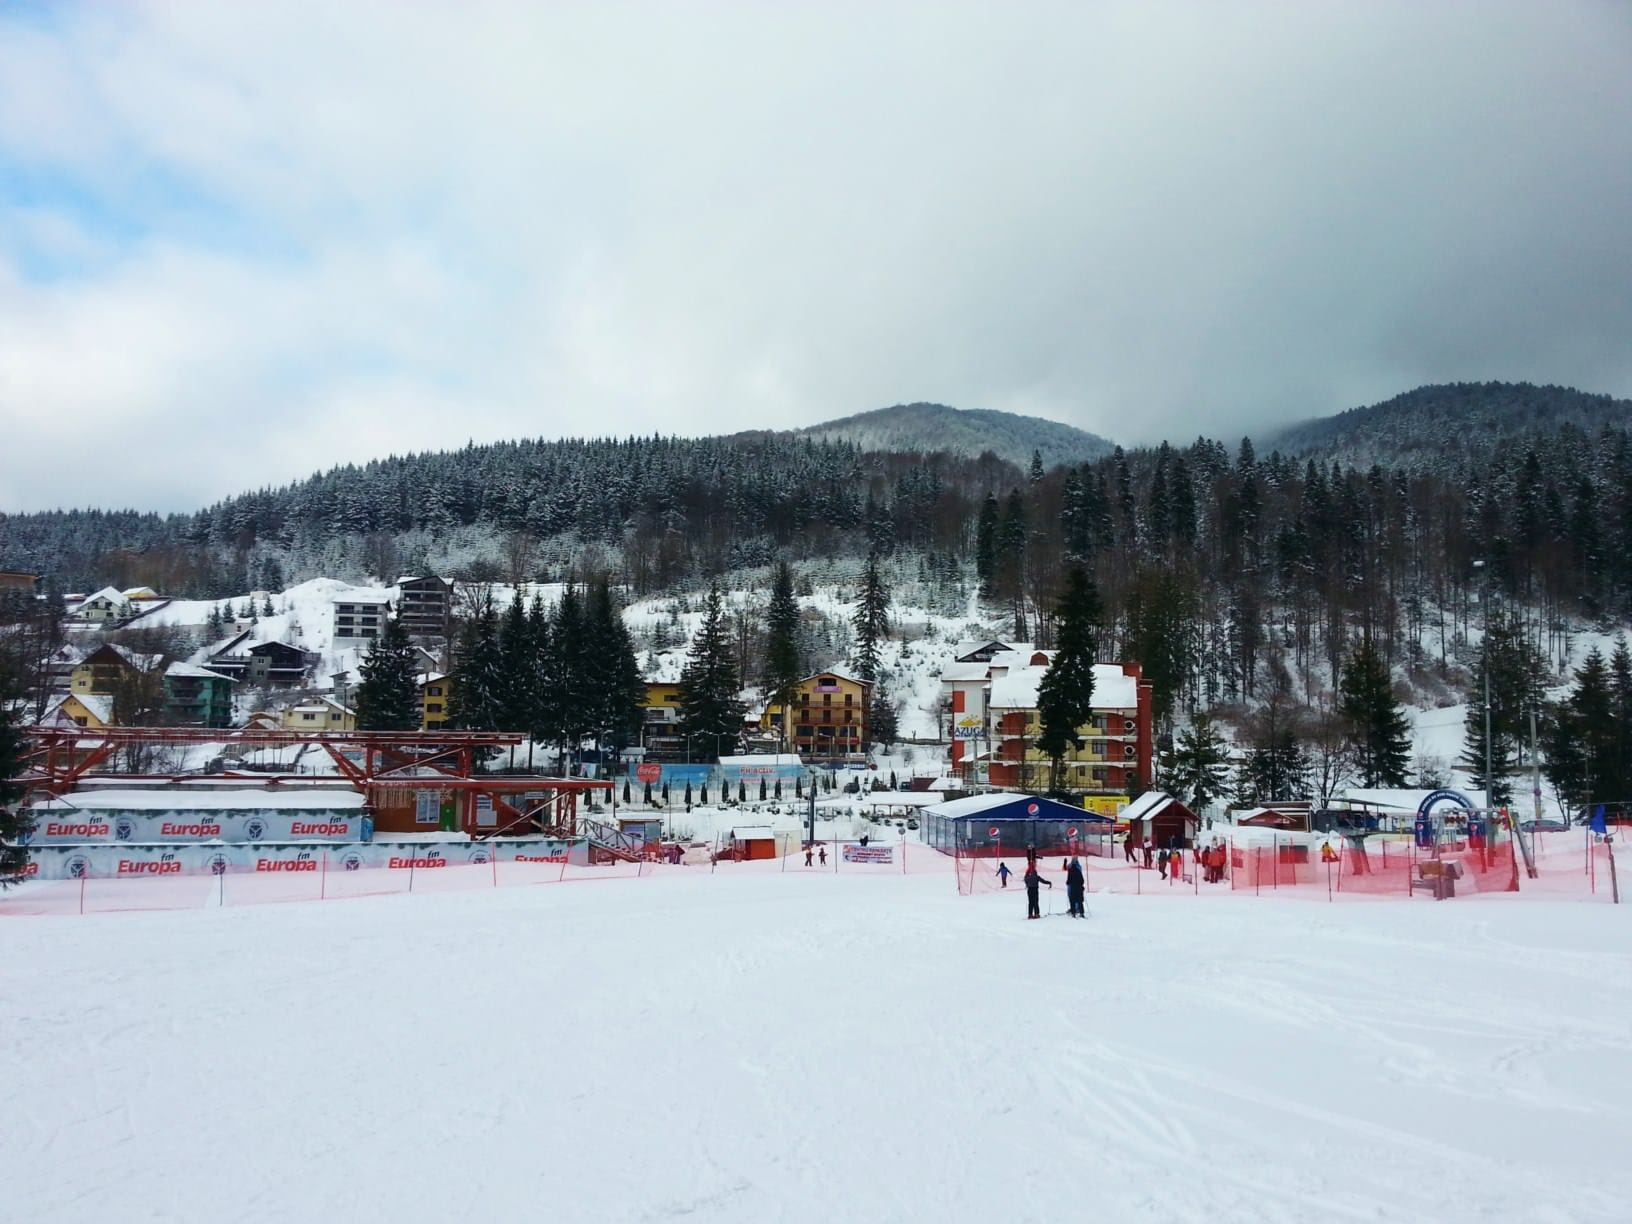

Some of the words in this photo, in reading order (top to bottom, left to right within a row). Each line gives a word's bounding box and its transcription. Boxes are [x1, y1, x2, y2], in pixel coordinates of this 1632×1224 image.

[955, 727, 987, 737] AZUGA
[89, 816, 102, 824] fm
[47, 823, 109, 837] Europa
[161, 823, 220, 837] Europa
[291, 822, 348, 836] Europa
[161, 853, 174, 861] fm
[297, 852, 310, 860] fm
[118, 860, 181, 874] Europa
[256, 858, 317, 872] Europa
[389, 857, 447, 869] Europa
